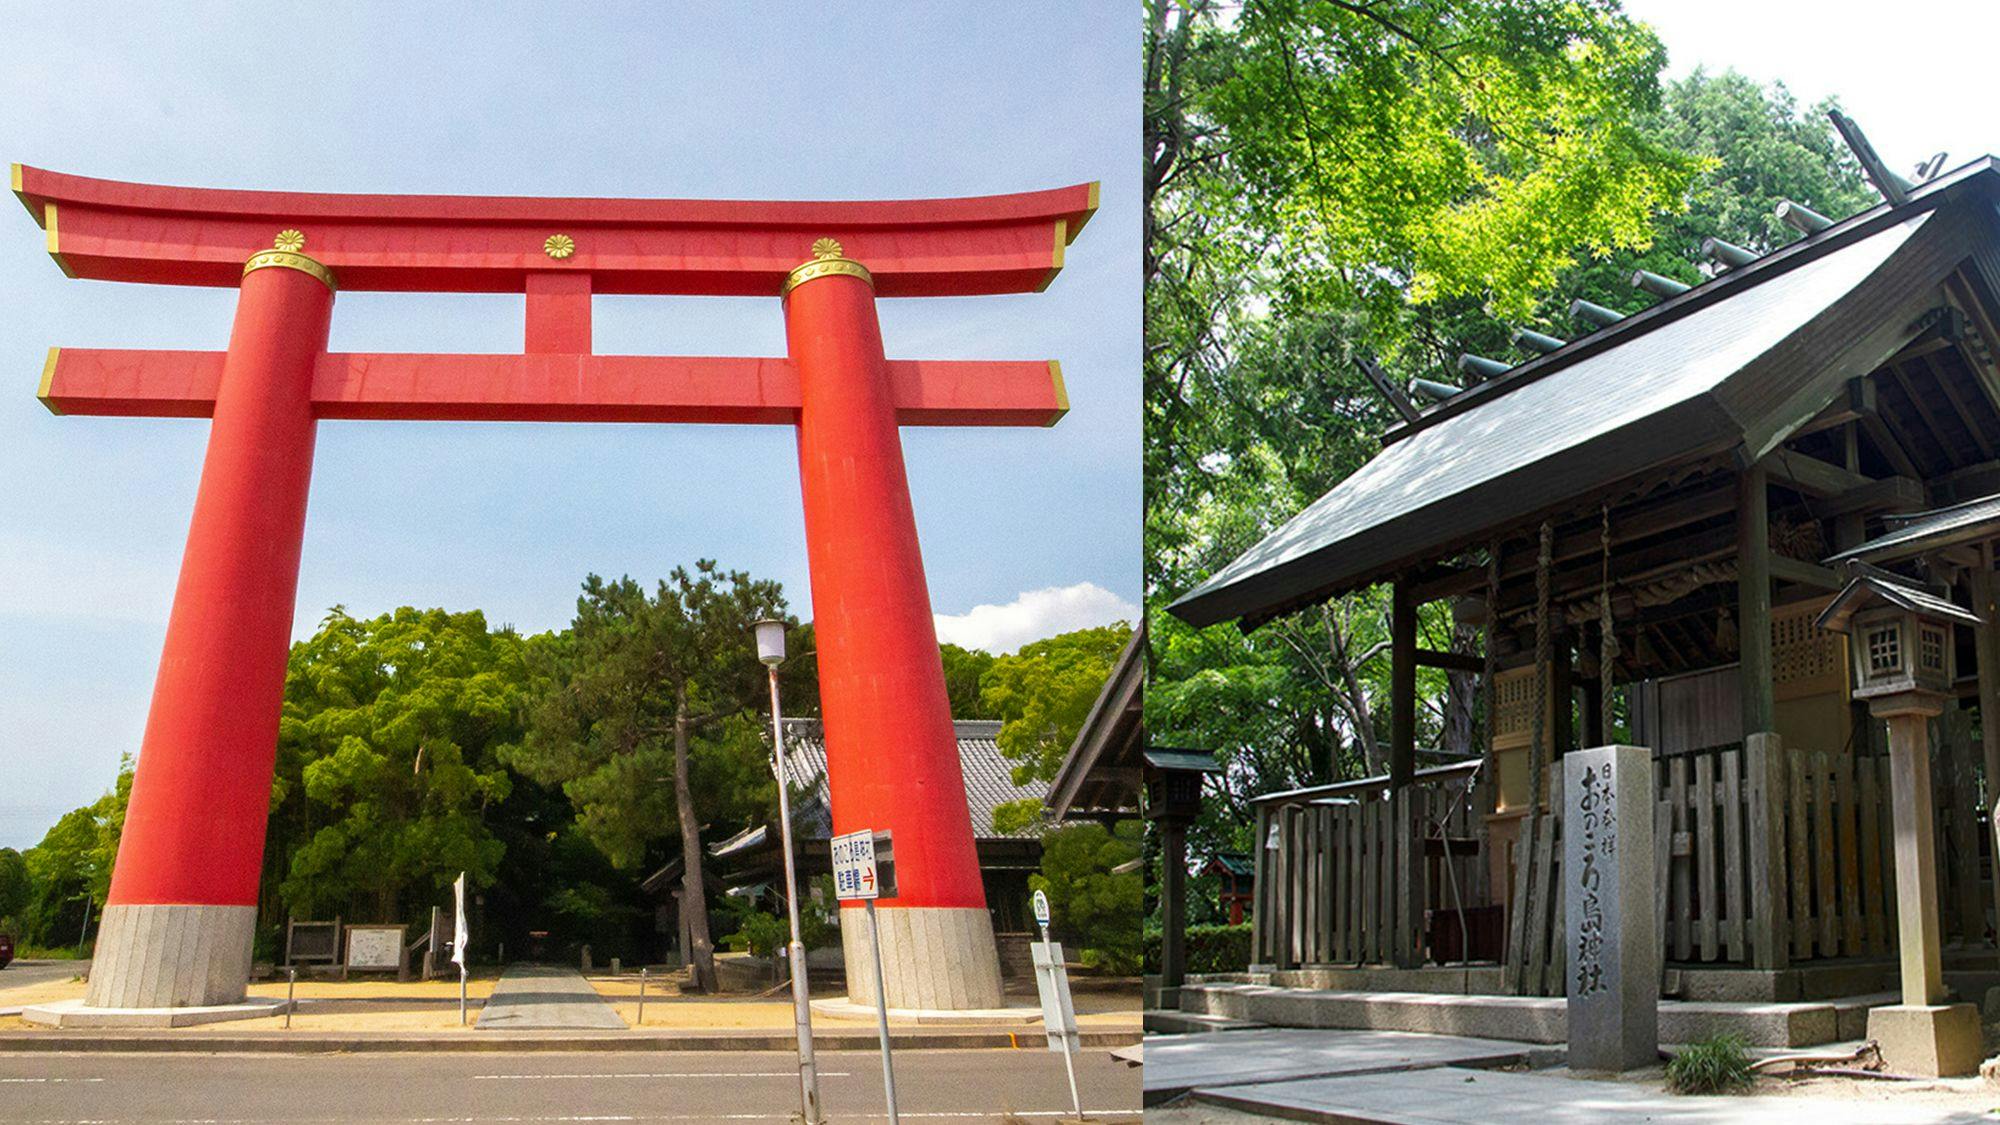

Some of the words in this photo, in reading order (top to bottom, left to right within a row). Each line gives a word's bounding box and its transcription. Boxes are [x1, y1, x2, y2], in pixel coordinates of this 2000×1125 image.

[1576, 765, 1608, 999] おのころ島神社
